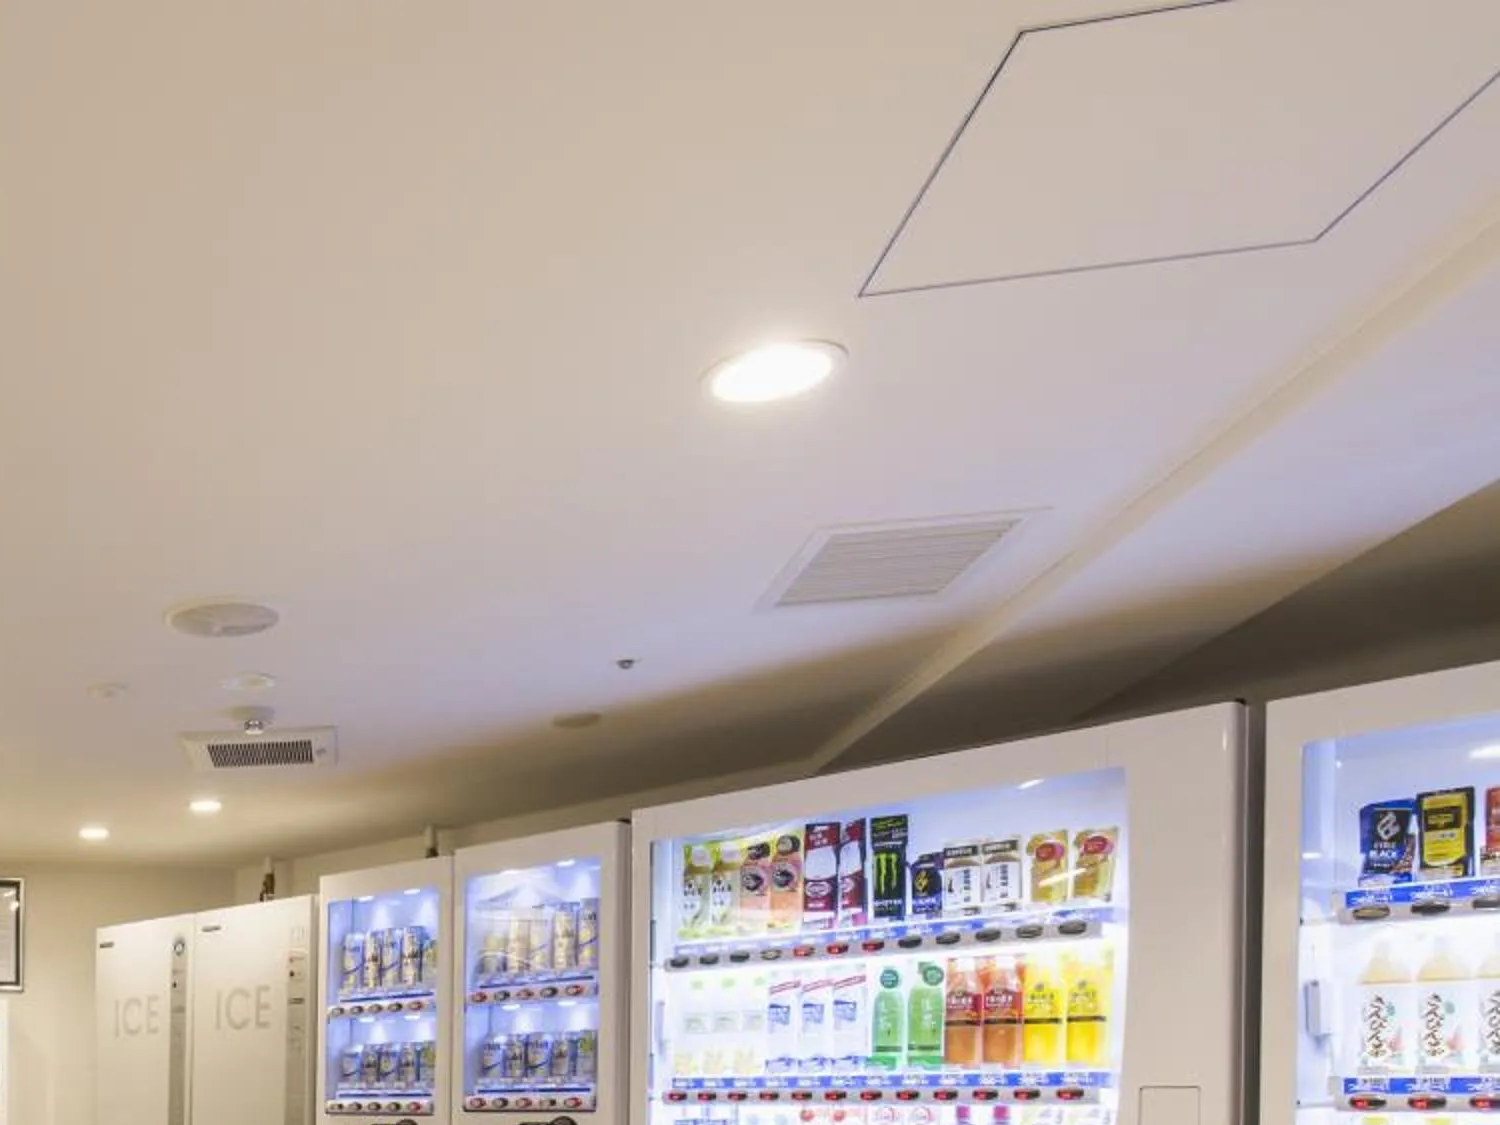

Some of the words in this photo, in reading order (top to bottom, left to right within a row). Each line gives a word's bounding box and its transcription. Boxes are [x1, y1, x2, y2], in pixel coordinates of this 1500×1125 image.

[1368, 849, 1399, 859] BLACK
[113, 994, 159, 1039] ICE
[215, 985, 271, 1031] ICE
